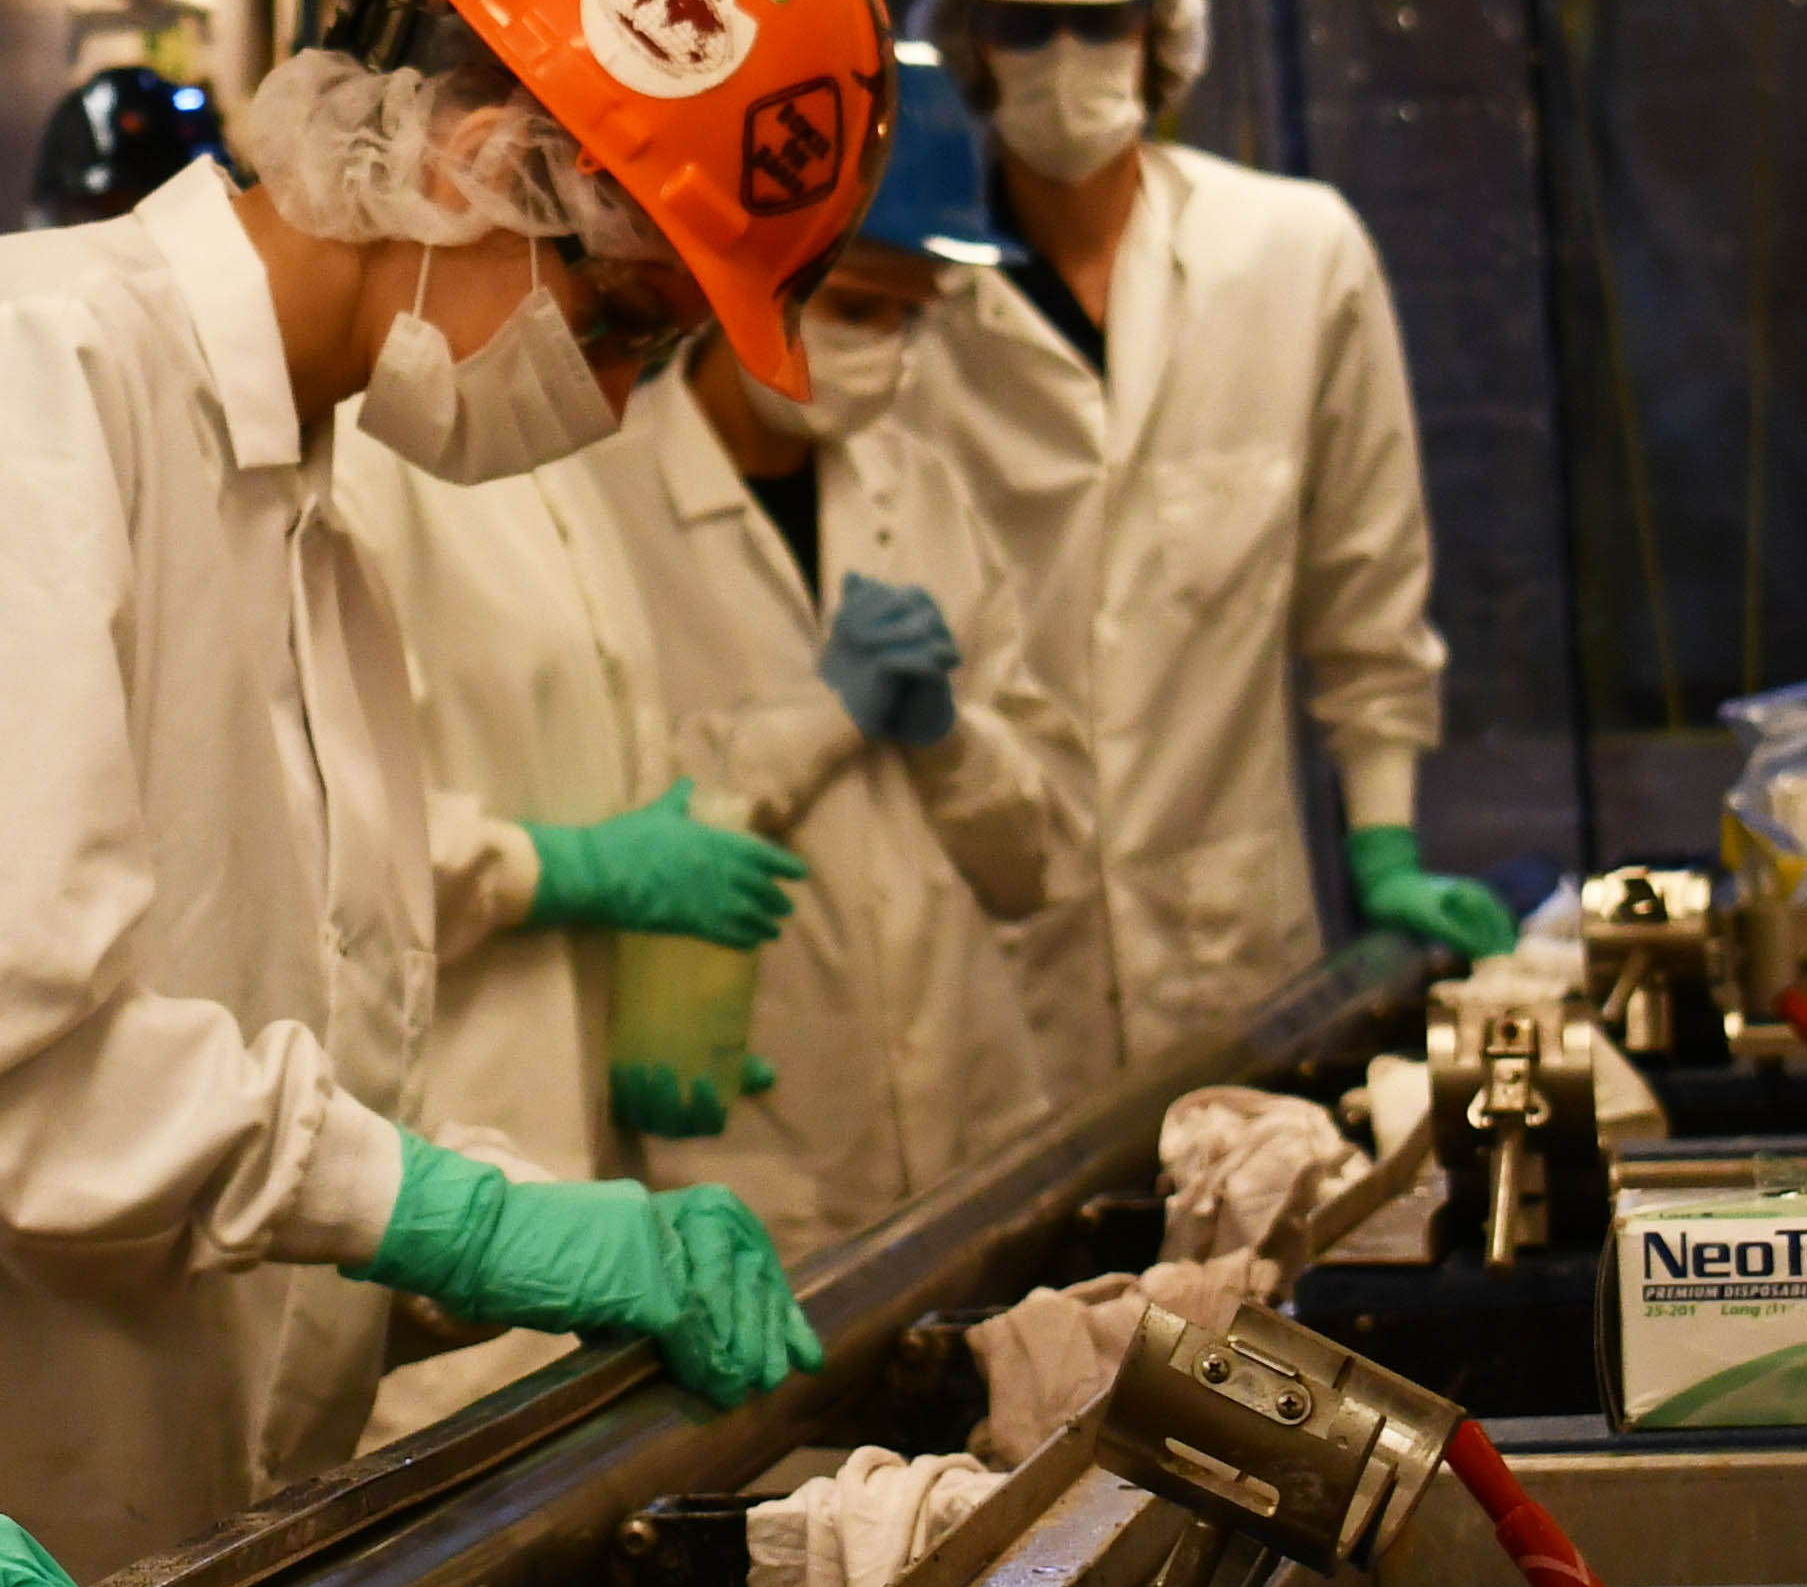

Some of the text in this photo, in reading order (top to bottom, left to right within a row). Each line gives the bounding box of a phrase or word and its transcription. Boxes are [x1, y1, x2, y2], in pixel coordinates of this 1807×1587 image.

[1645, 1285, 1719, 1300] PREMIUM
[1644, 1303, 1697, 1317] 25-201
[1720, 1303, 1761, 1319] Long
